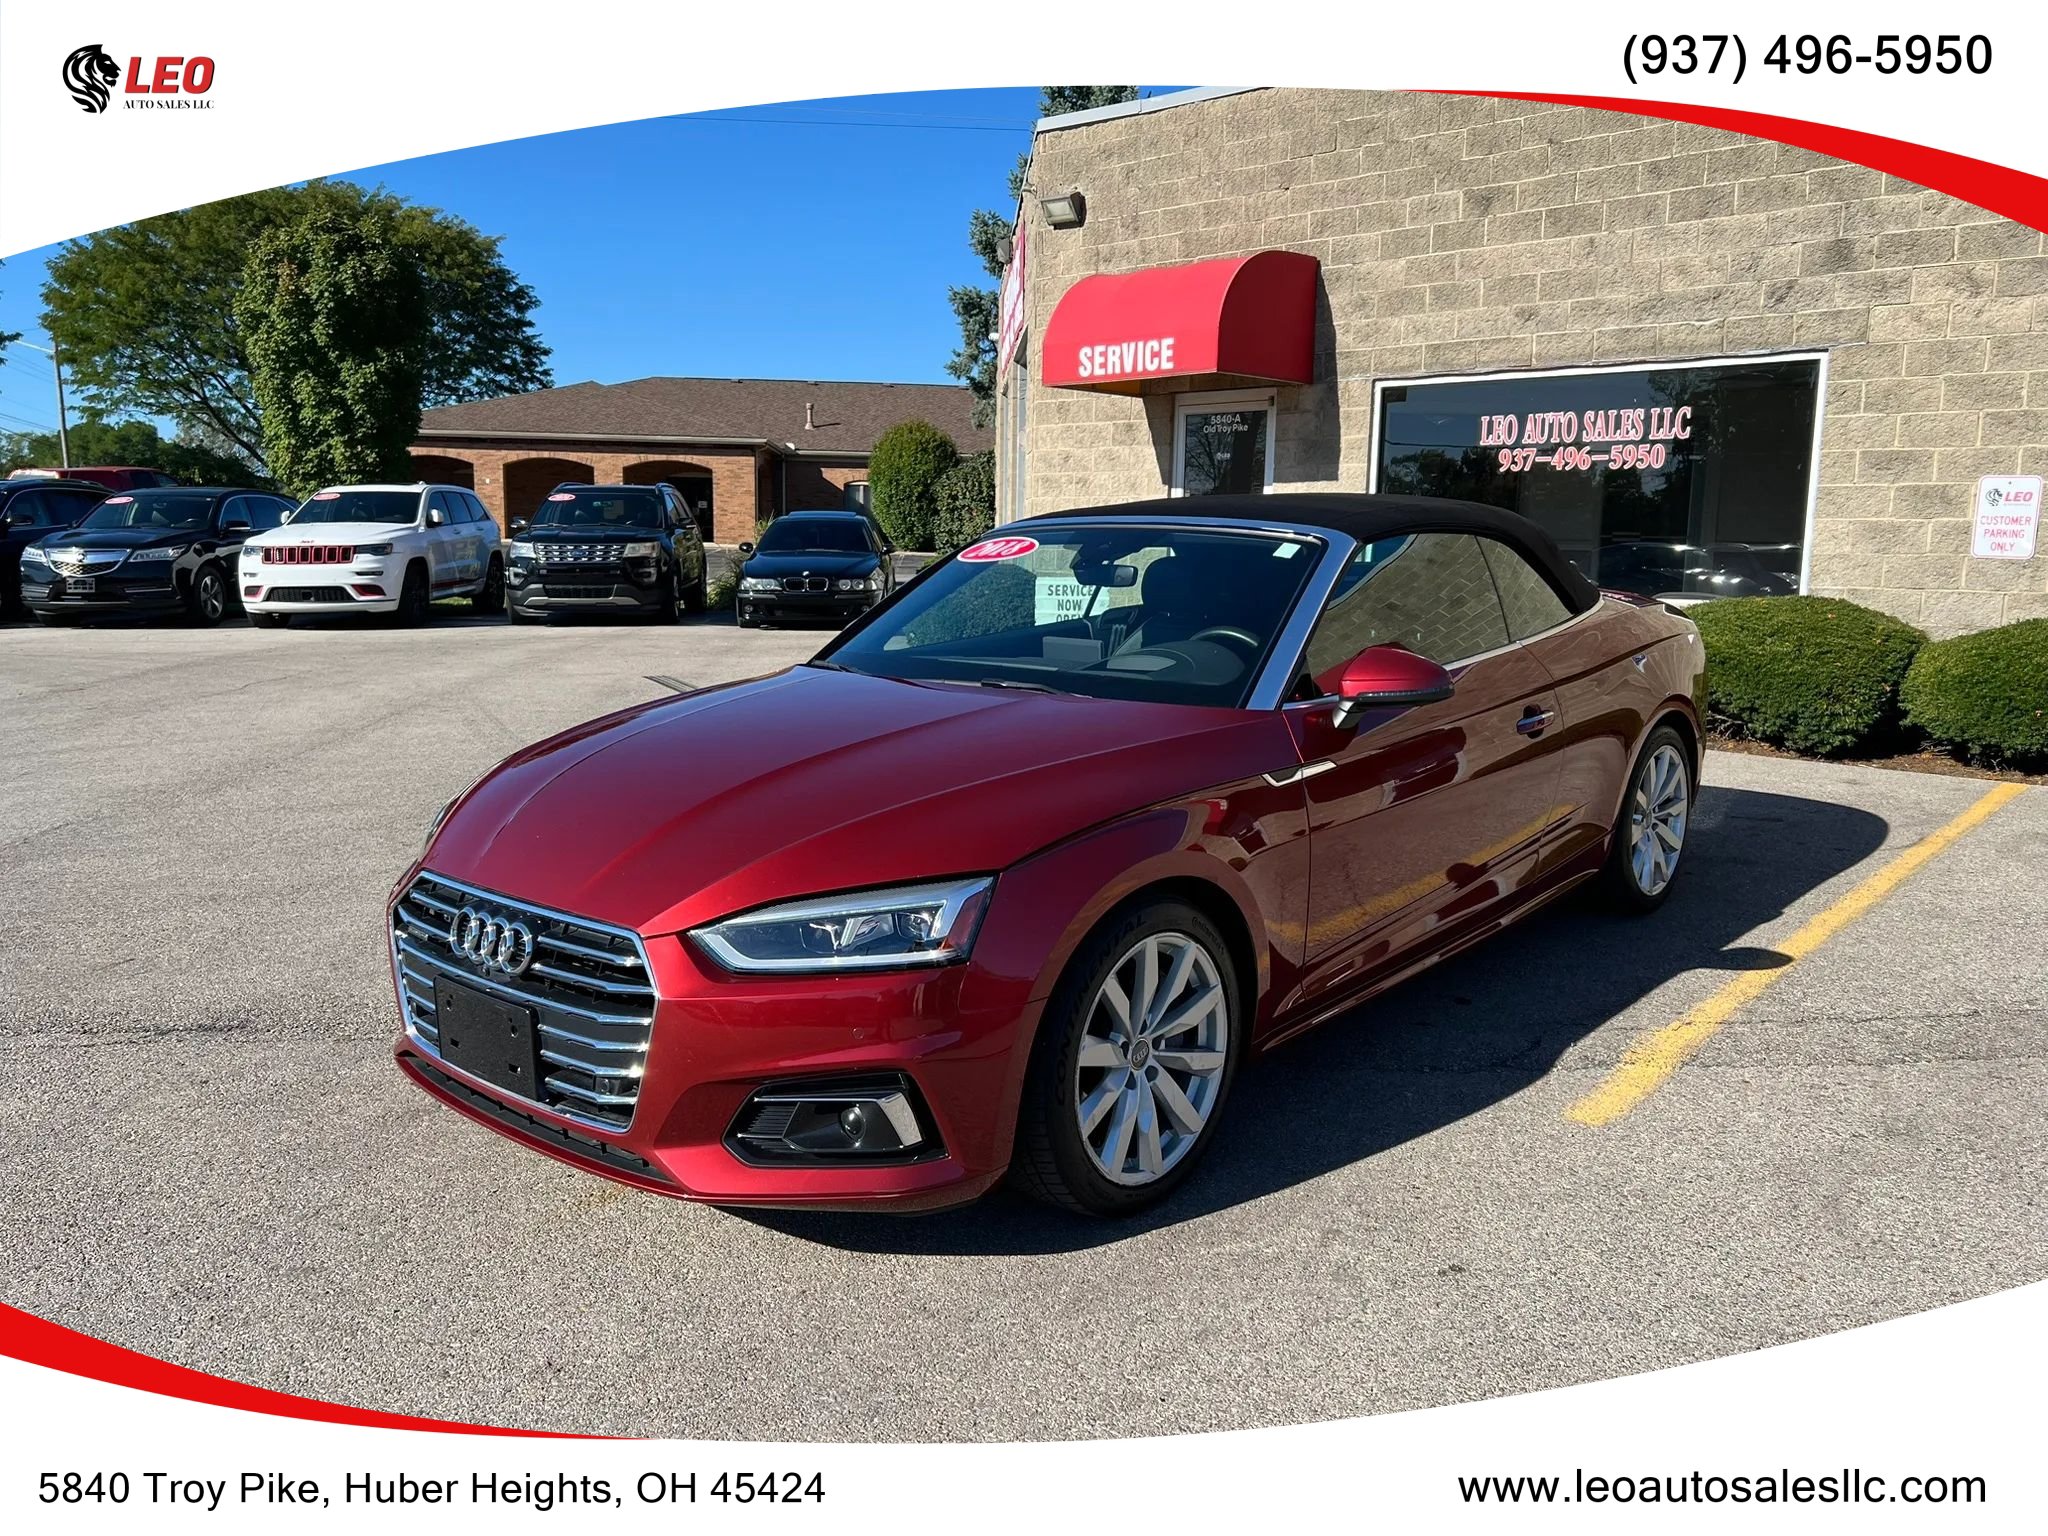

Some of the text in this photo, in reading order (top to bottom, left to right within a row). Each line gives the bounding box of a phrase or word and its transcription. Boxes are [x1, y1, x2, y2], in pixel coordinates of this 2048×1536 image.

[1078, 338, 1175, 378] SERVICE
[1211, 414, 1241, 424] 5840-A
[1203, 423, 1248, 434] Old Troy Pike
[1480, 406, 1692, 445] LEO AUTO SALES LLC
[1498, 443, 1665, 472] 937-496-5950
[2004, 491, 2033, 502] LEO
[1980, 515, 2032, 526] CUSTOMER
[1983, 528, 2025, 539] PARKING
[964, 541, 1031, 557] 2018
[1990, 541, 2016, 552] ONLY
[1047, 584, 1093, 597] SERVICE
[1057, 599, 1082, 611] NOW
